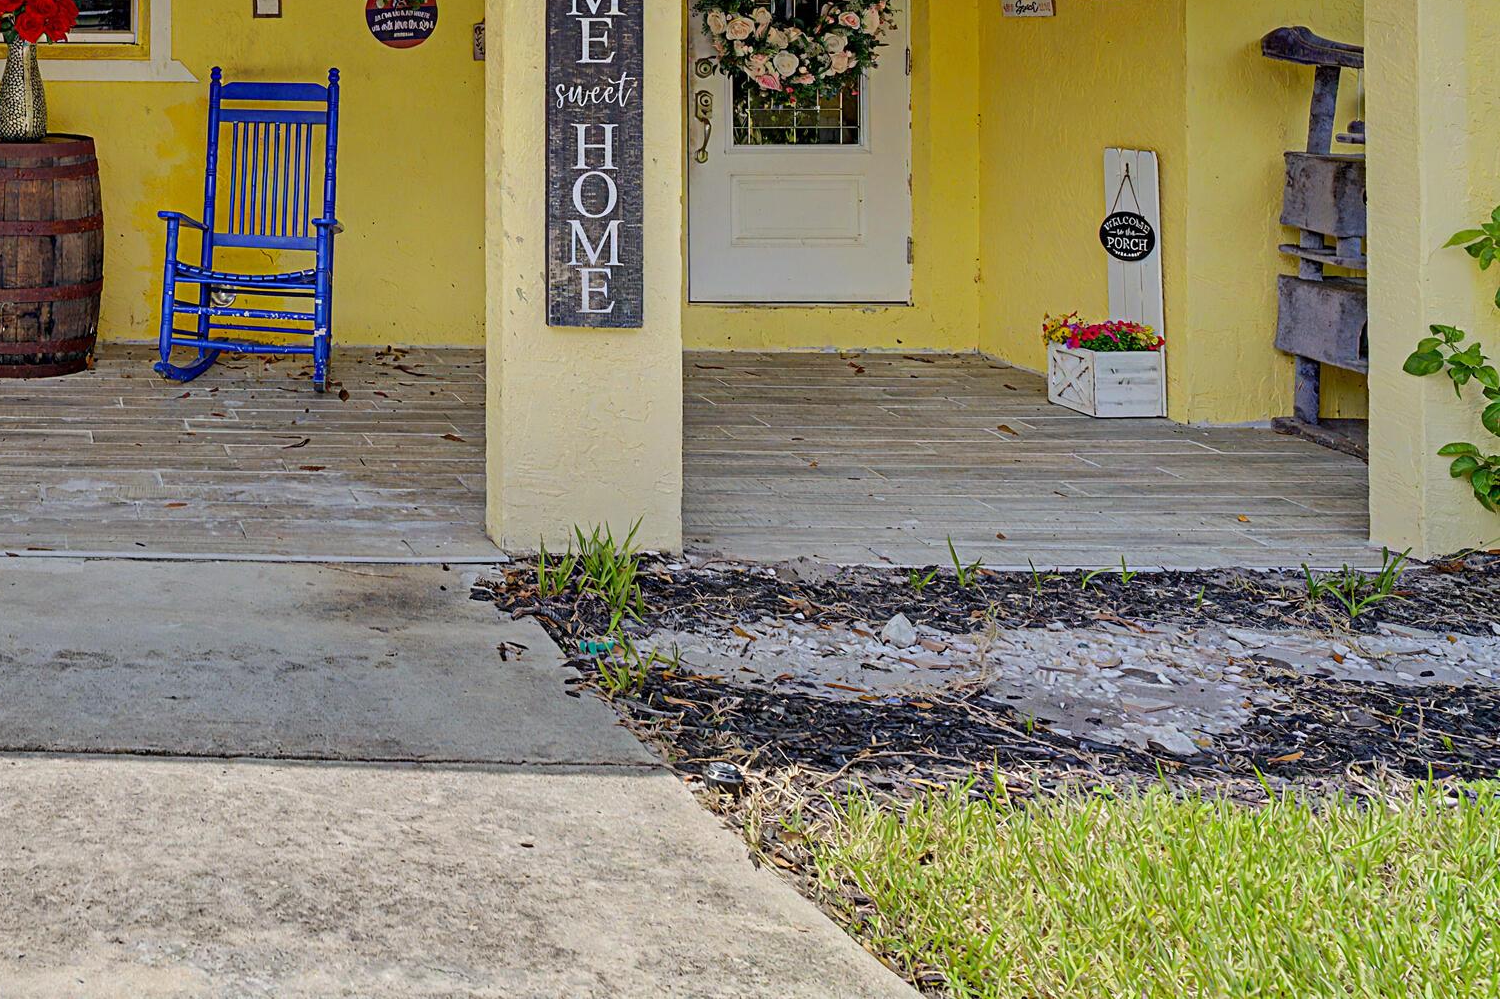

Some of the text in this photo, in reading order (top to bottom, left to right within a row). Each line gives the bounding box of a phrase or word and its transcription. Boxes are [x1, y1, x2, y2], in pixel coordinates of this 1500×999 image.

[555, 71, 636, 109] sweet
[566, 123, 625, 314] HOME
[1104, 216, 1151, 234] WELCOME
[1106, 236, 1149, 252] PORCH
